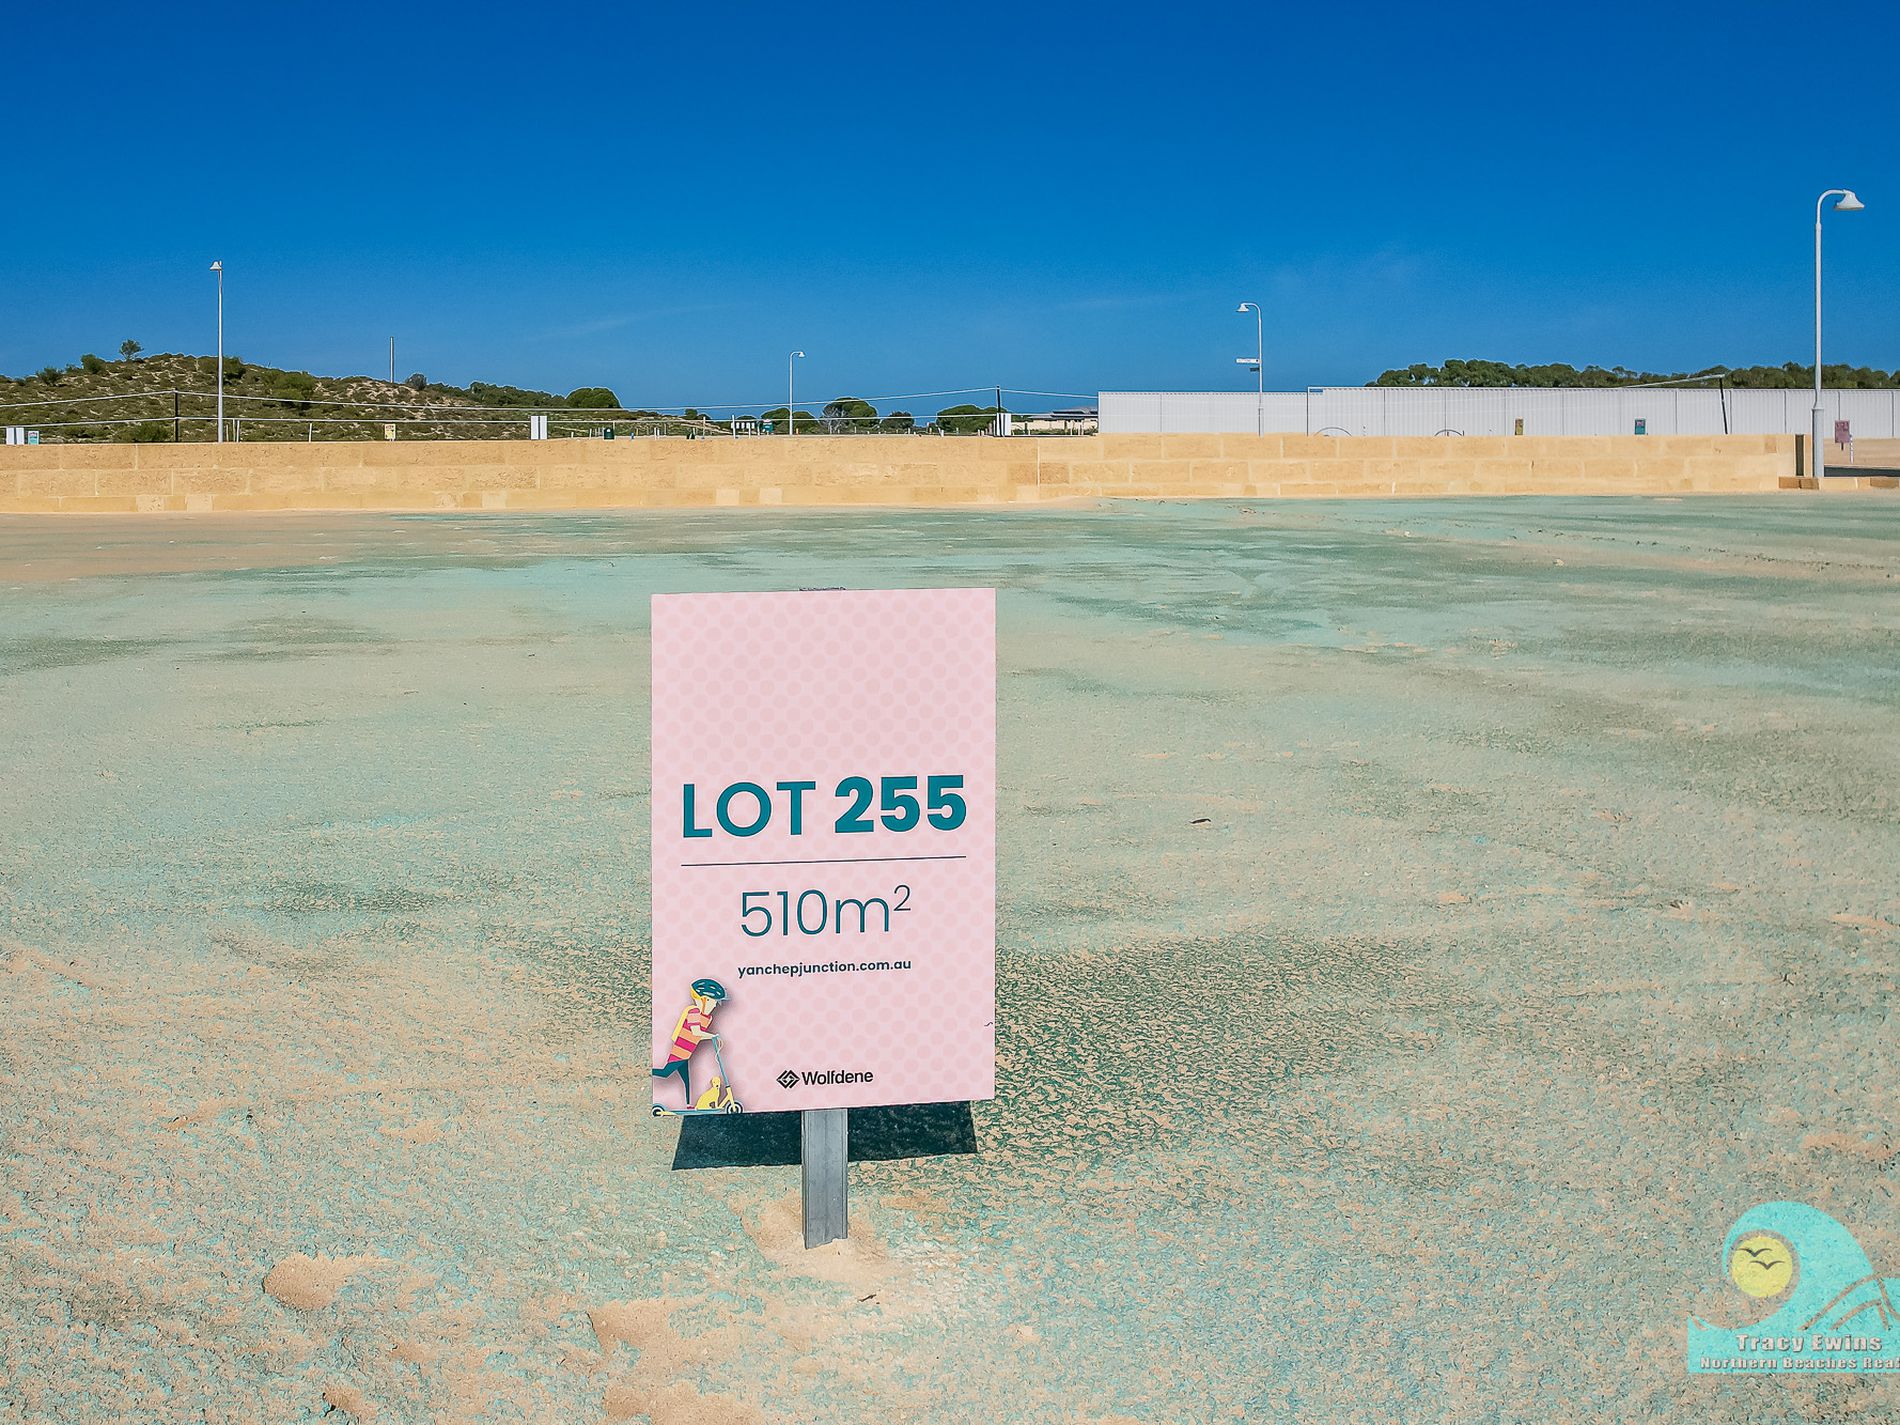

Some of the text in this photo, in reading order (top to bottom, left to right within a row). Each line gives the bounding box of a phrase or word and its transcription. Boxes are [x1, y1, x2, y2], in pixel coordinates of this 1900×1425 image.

[683, 774, 967, 838] LOT 255
[738, 960, 912, 979] yanchepjunction.com.au
[801, 1069, 874, 1086] Wolfdene
